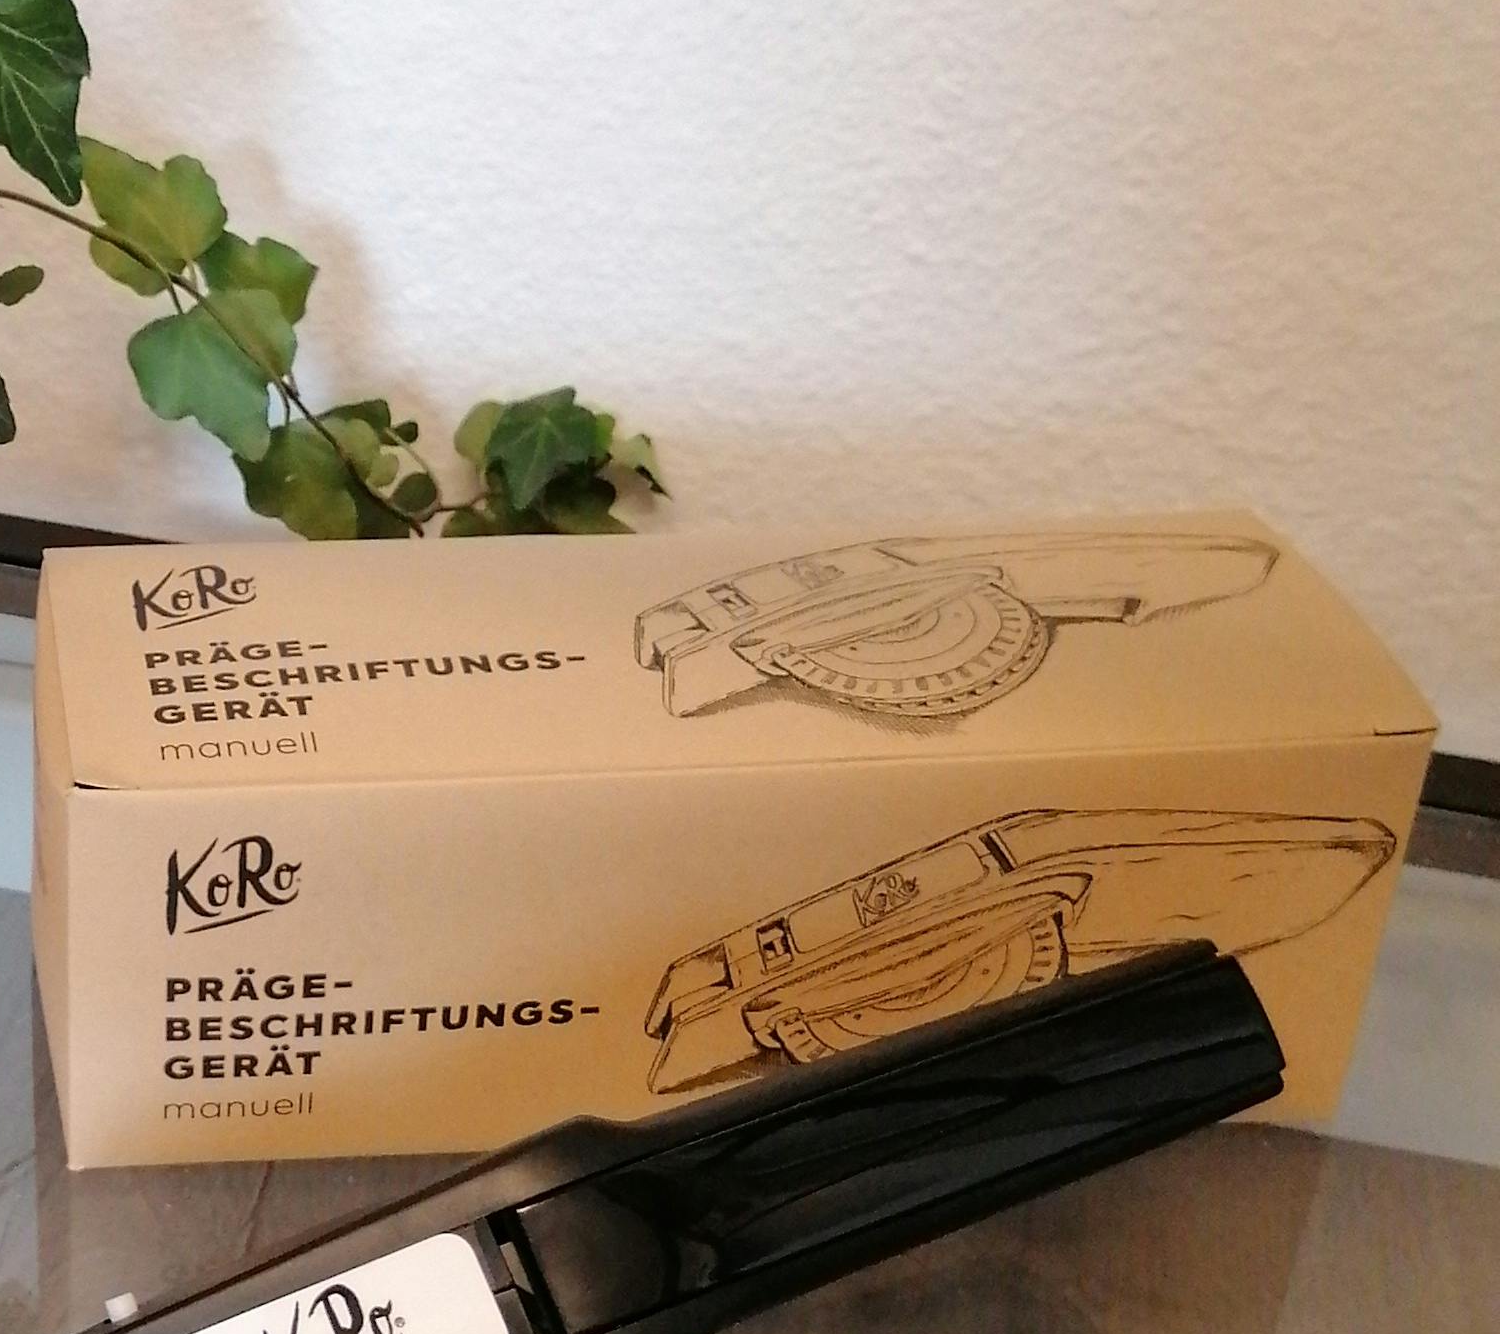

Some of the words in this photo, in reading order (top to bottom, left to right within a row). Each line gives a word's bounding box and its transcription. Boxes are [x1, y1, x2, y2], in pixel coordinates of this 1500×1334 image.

[131, 564, 258, 632] KoRo
[144, 640, 329, 669] PRÄGE-
[148, 650, 586, 697] BESCHRIFTUNGS-
[153, 691, 314, 725] GERÄT
[160, 730, 318, 762] manuell
[165, 834, 303, 936] KoRo
[165, 967, 354, 1003] PRÄGE-
[165, 998, 601, 1043] BESCHRIFTUNGS-
[163, 1044, 322, 1080] GERÄT
[162, 1091, 314, 1121] manuell
